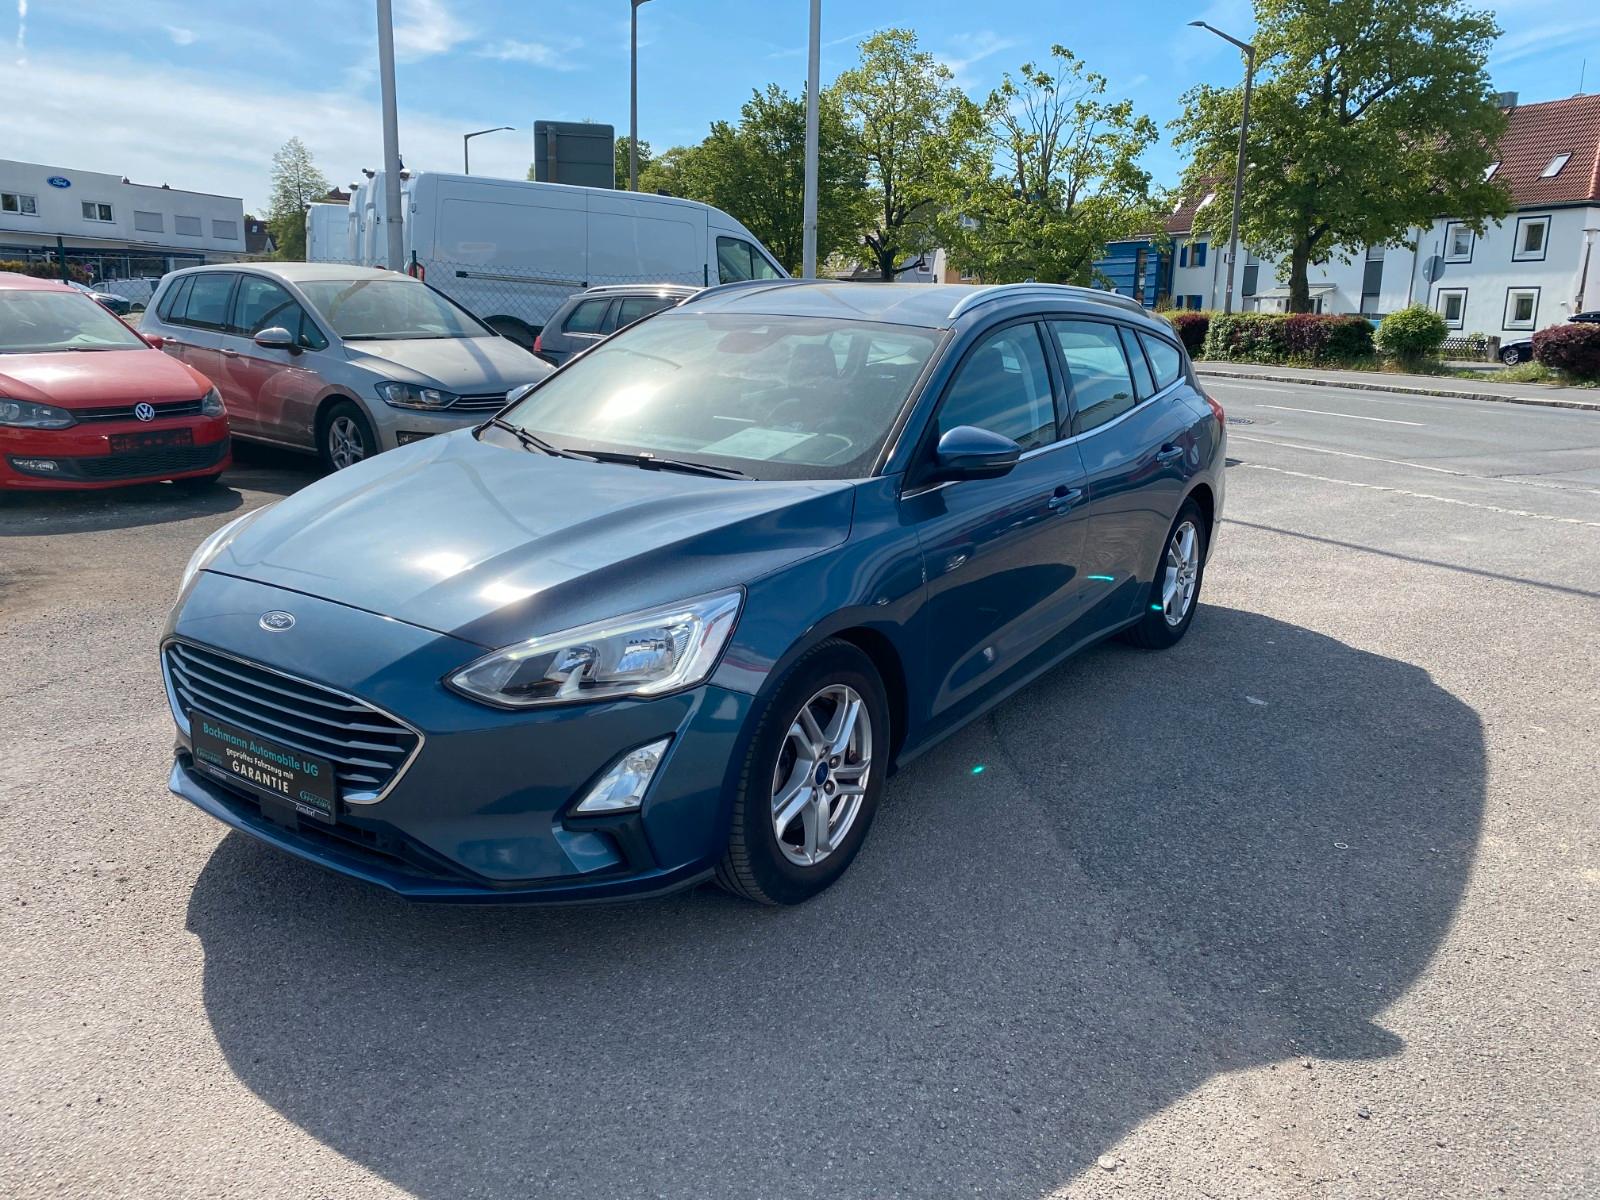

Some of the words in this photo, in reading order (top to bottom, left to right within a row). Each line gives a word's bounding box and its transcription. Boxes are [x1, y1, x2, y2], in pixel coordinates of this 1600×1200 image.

[203, 722, 248, 749] Bachmann
[249, 741, 300, 770] Automobile
[302, 761, 319, 777] UG
[232, 760, 289, 794] GARANTIE
[254, 757, 282, 777] Fahrzeug
[282, 770, 294, 780] mit
